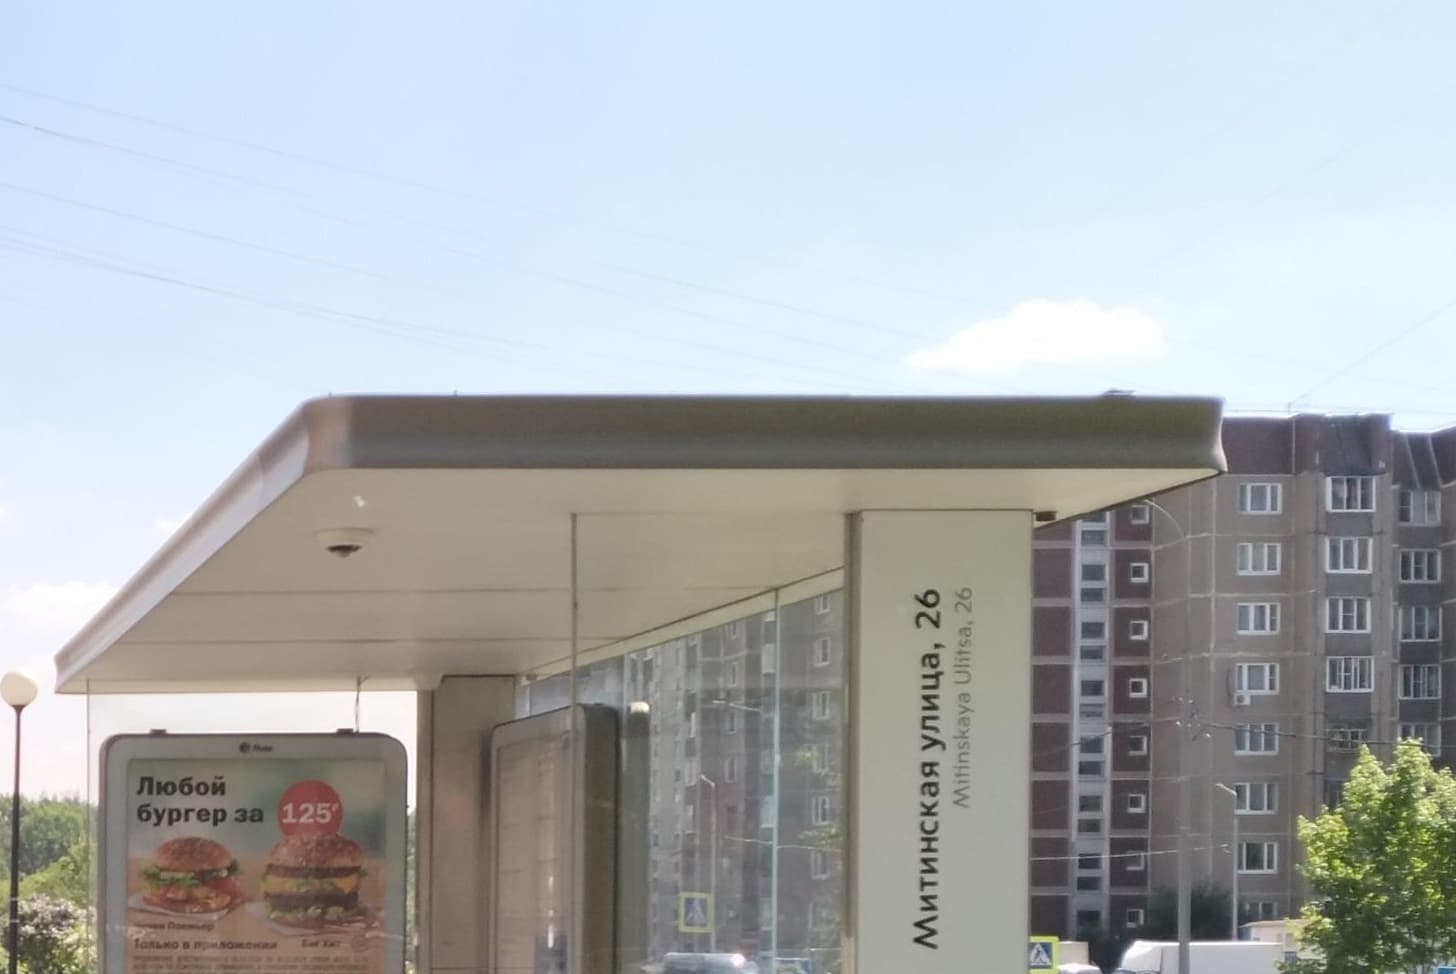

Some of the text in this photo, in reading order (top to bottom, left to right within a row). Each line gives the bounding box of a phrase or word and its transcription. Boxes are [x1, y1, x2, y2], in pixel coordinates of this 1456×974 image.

[952, 586, 975, 809] Mitinskaya Ulitsa, 26
[136, 775, 227, 797] Любой
[137, 803, 264, 827] бургер за
[913, 588, 947, 950] Митинская улица, 26
